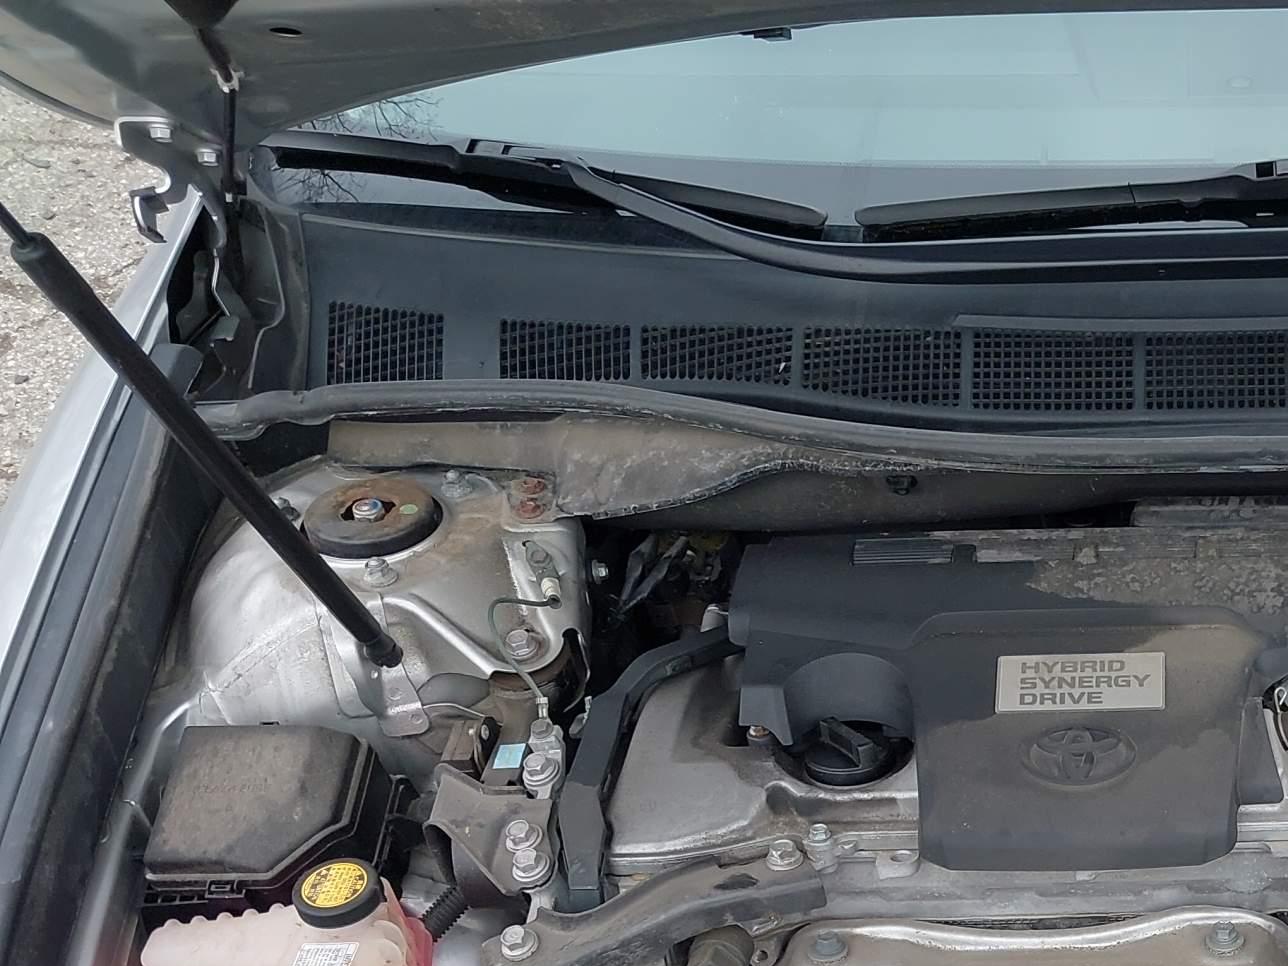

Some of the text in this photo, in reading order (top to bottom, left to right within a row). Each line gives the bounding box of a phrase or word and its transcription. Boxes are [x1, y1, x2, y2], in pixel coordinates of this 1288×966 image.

[1021, 660, 1126, 674] HYBRID
[1020, 674, 1151, 690] SYNERGY
[1019, 691, 1103, 706] DRIVE
